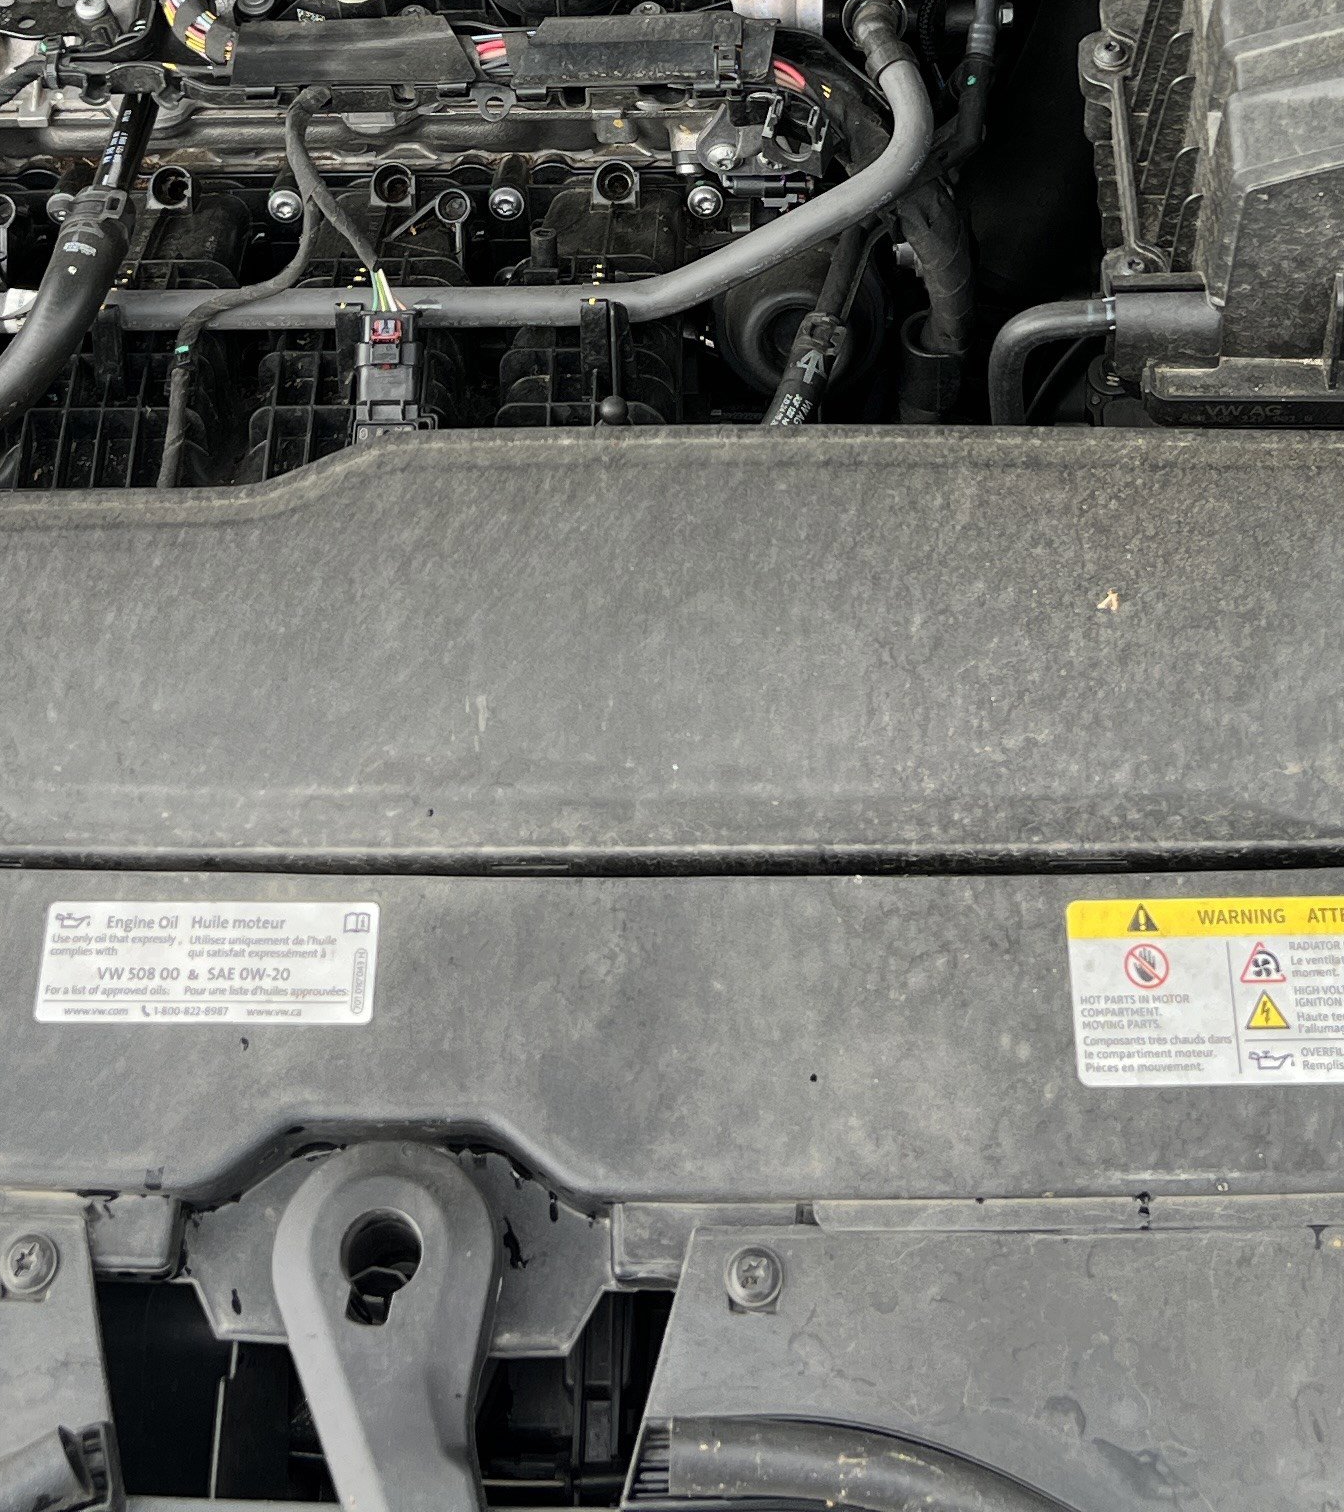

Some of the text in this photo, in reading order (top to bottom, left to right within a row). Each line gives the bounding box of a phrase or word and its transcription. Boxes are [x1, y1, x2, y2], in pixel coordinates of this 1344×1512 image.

[1196, 907, 1287, 926] WARNING
[106, 915, 286, 932] Engine Oil Huile moteur
[1288, 940, 1341, 950] RADIATOR
[1290, 955, 1303, 965] Le
[96, 966, 290, 981] VW 508 00 & SAE 0W-20
[1293, 985, 1321, 995] HIGH
[1079, 993, 1190, 1005] HOT PARTS IN MOTOR
[1294, 996, 1343, 1007] IGNITION
[1296, 1011, 1329, 1021] Haute
[1082, 1034, 1145, 1047] Composants
[1169, 1033, 1206, 1044] chauds
[1206, 1033, 1233, 1044] dans
[1083, 1049, 1094, 1059] le
[1095, 1047, 1172, 1061] compartiment
[1121, 1064, 1136, 1072] en
